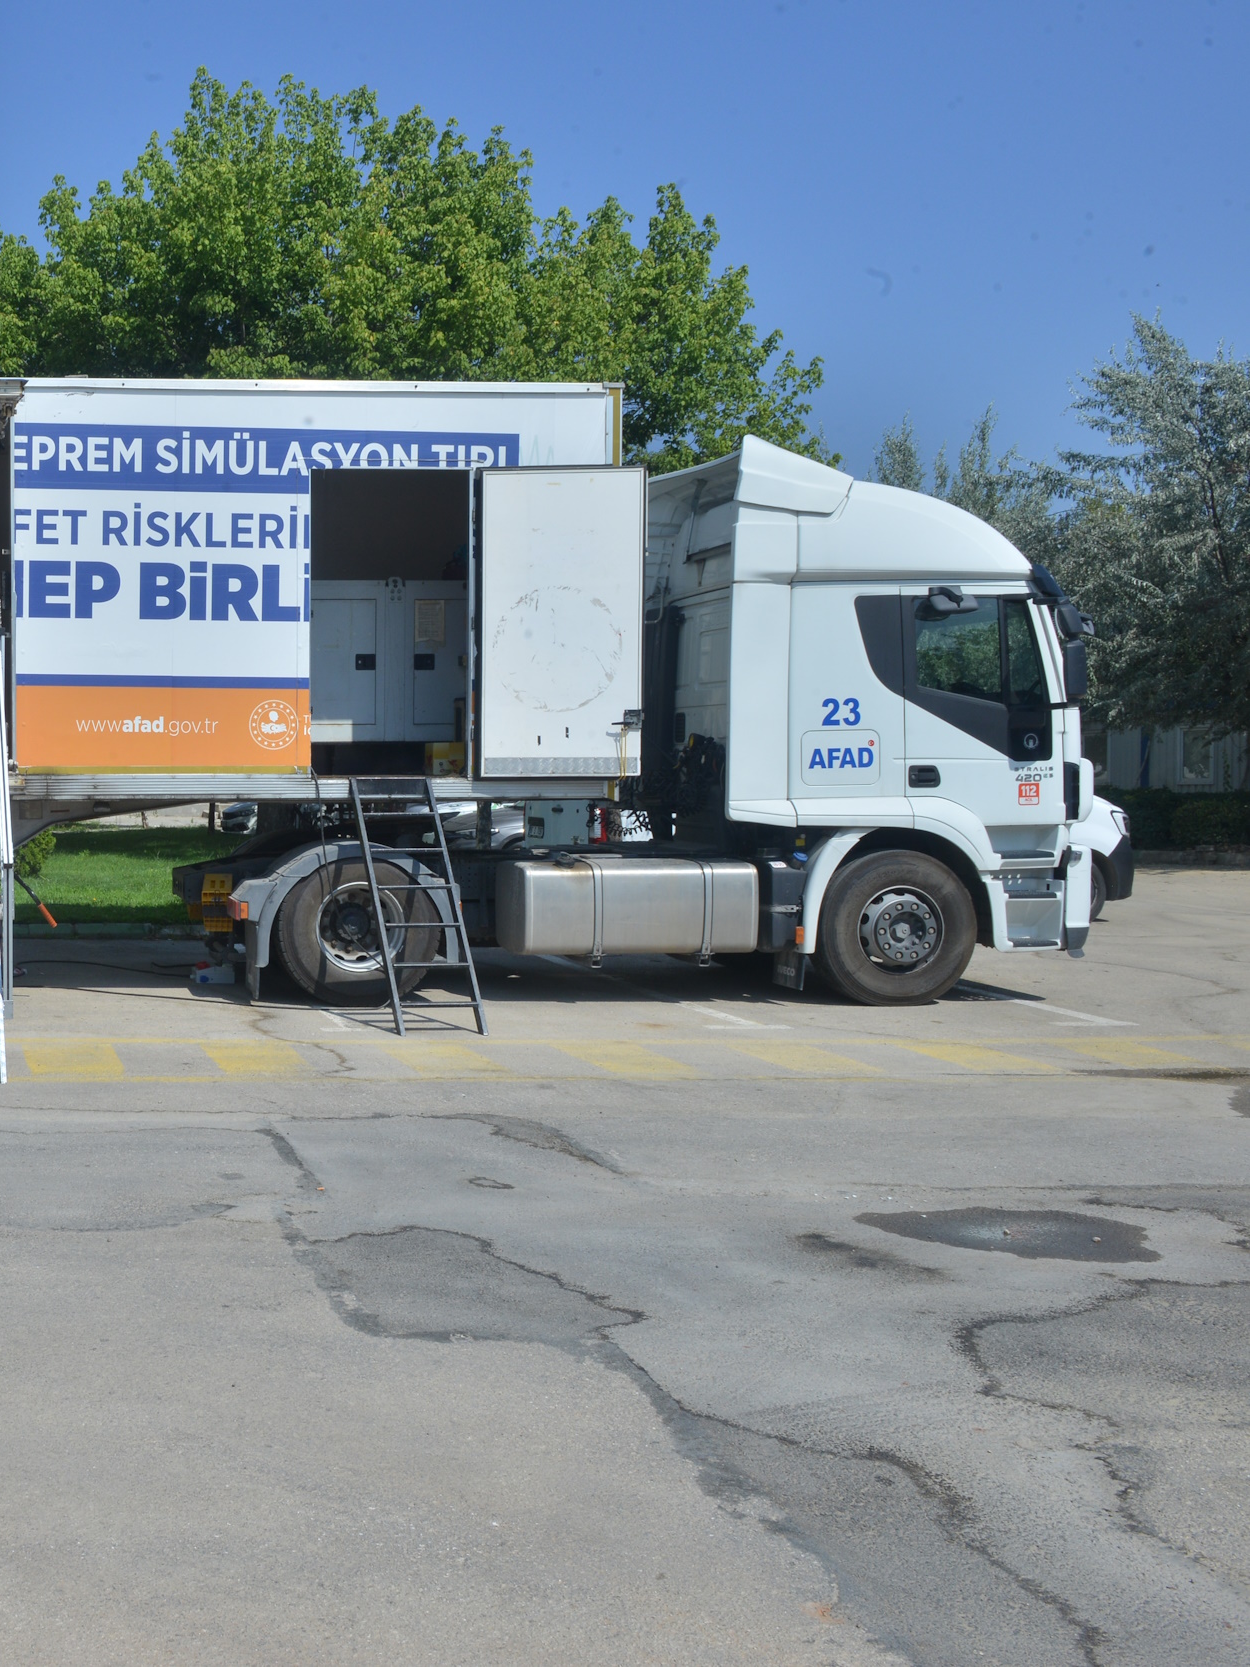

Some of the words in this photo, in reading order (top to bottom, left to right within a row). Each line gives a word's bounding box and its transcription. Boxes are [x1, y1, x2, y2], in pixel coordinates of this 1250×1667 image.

[102, 502, 310, 549] RİSKLERİ
[14, 560, 121, 619] EP
[821, 697, 861, 726] 23
[808, 747, 874, 769] AFAD
[1015, 773, 1042, 783] 420
[1021, 785, 1037, 797] 112
